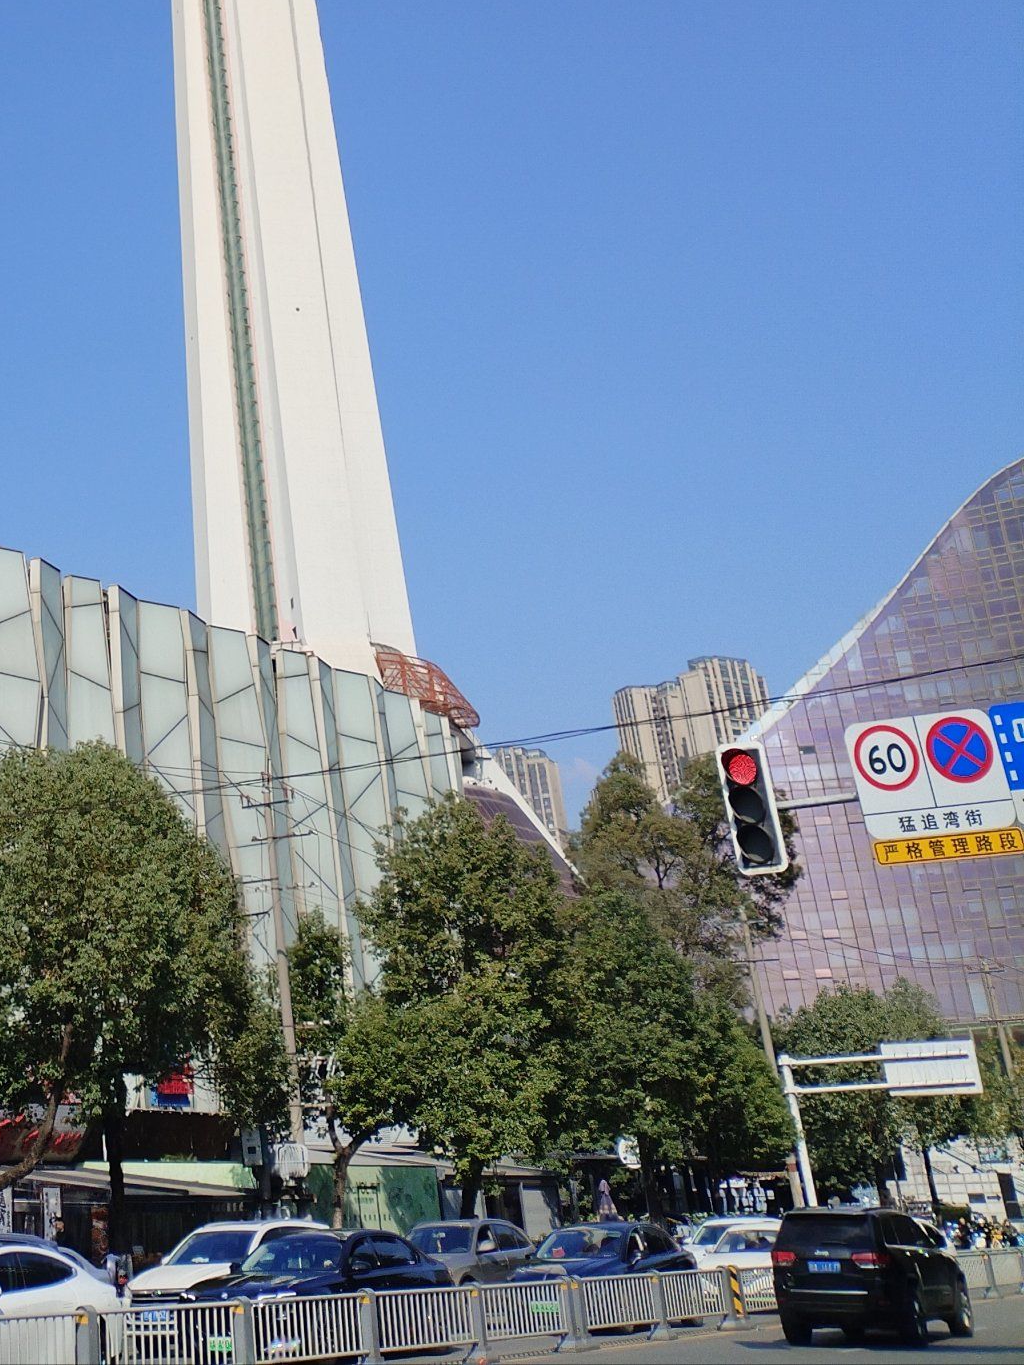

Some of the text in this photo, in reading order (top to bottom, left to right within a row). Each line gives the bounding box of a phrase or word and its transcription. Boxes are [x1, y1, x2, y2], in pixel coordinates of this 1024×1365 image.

[868, 742, 907, 776] 60
[898, 809, 983, 834] 猛追湾街
[883, 832, 1019, 862] 严格管理路段
